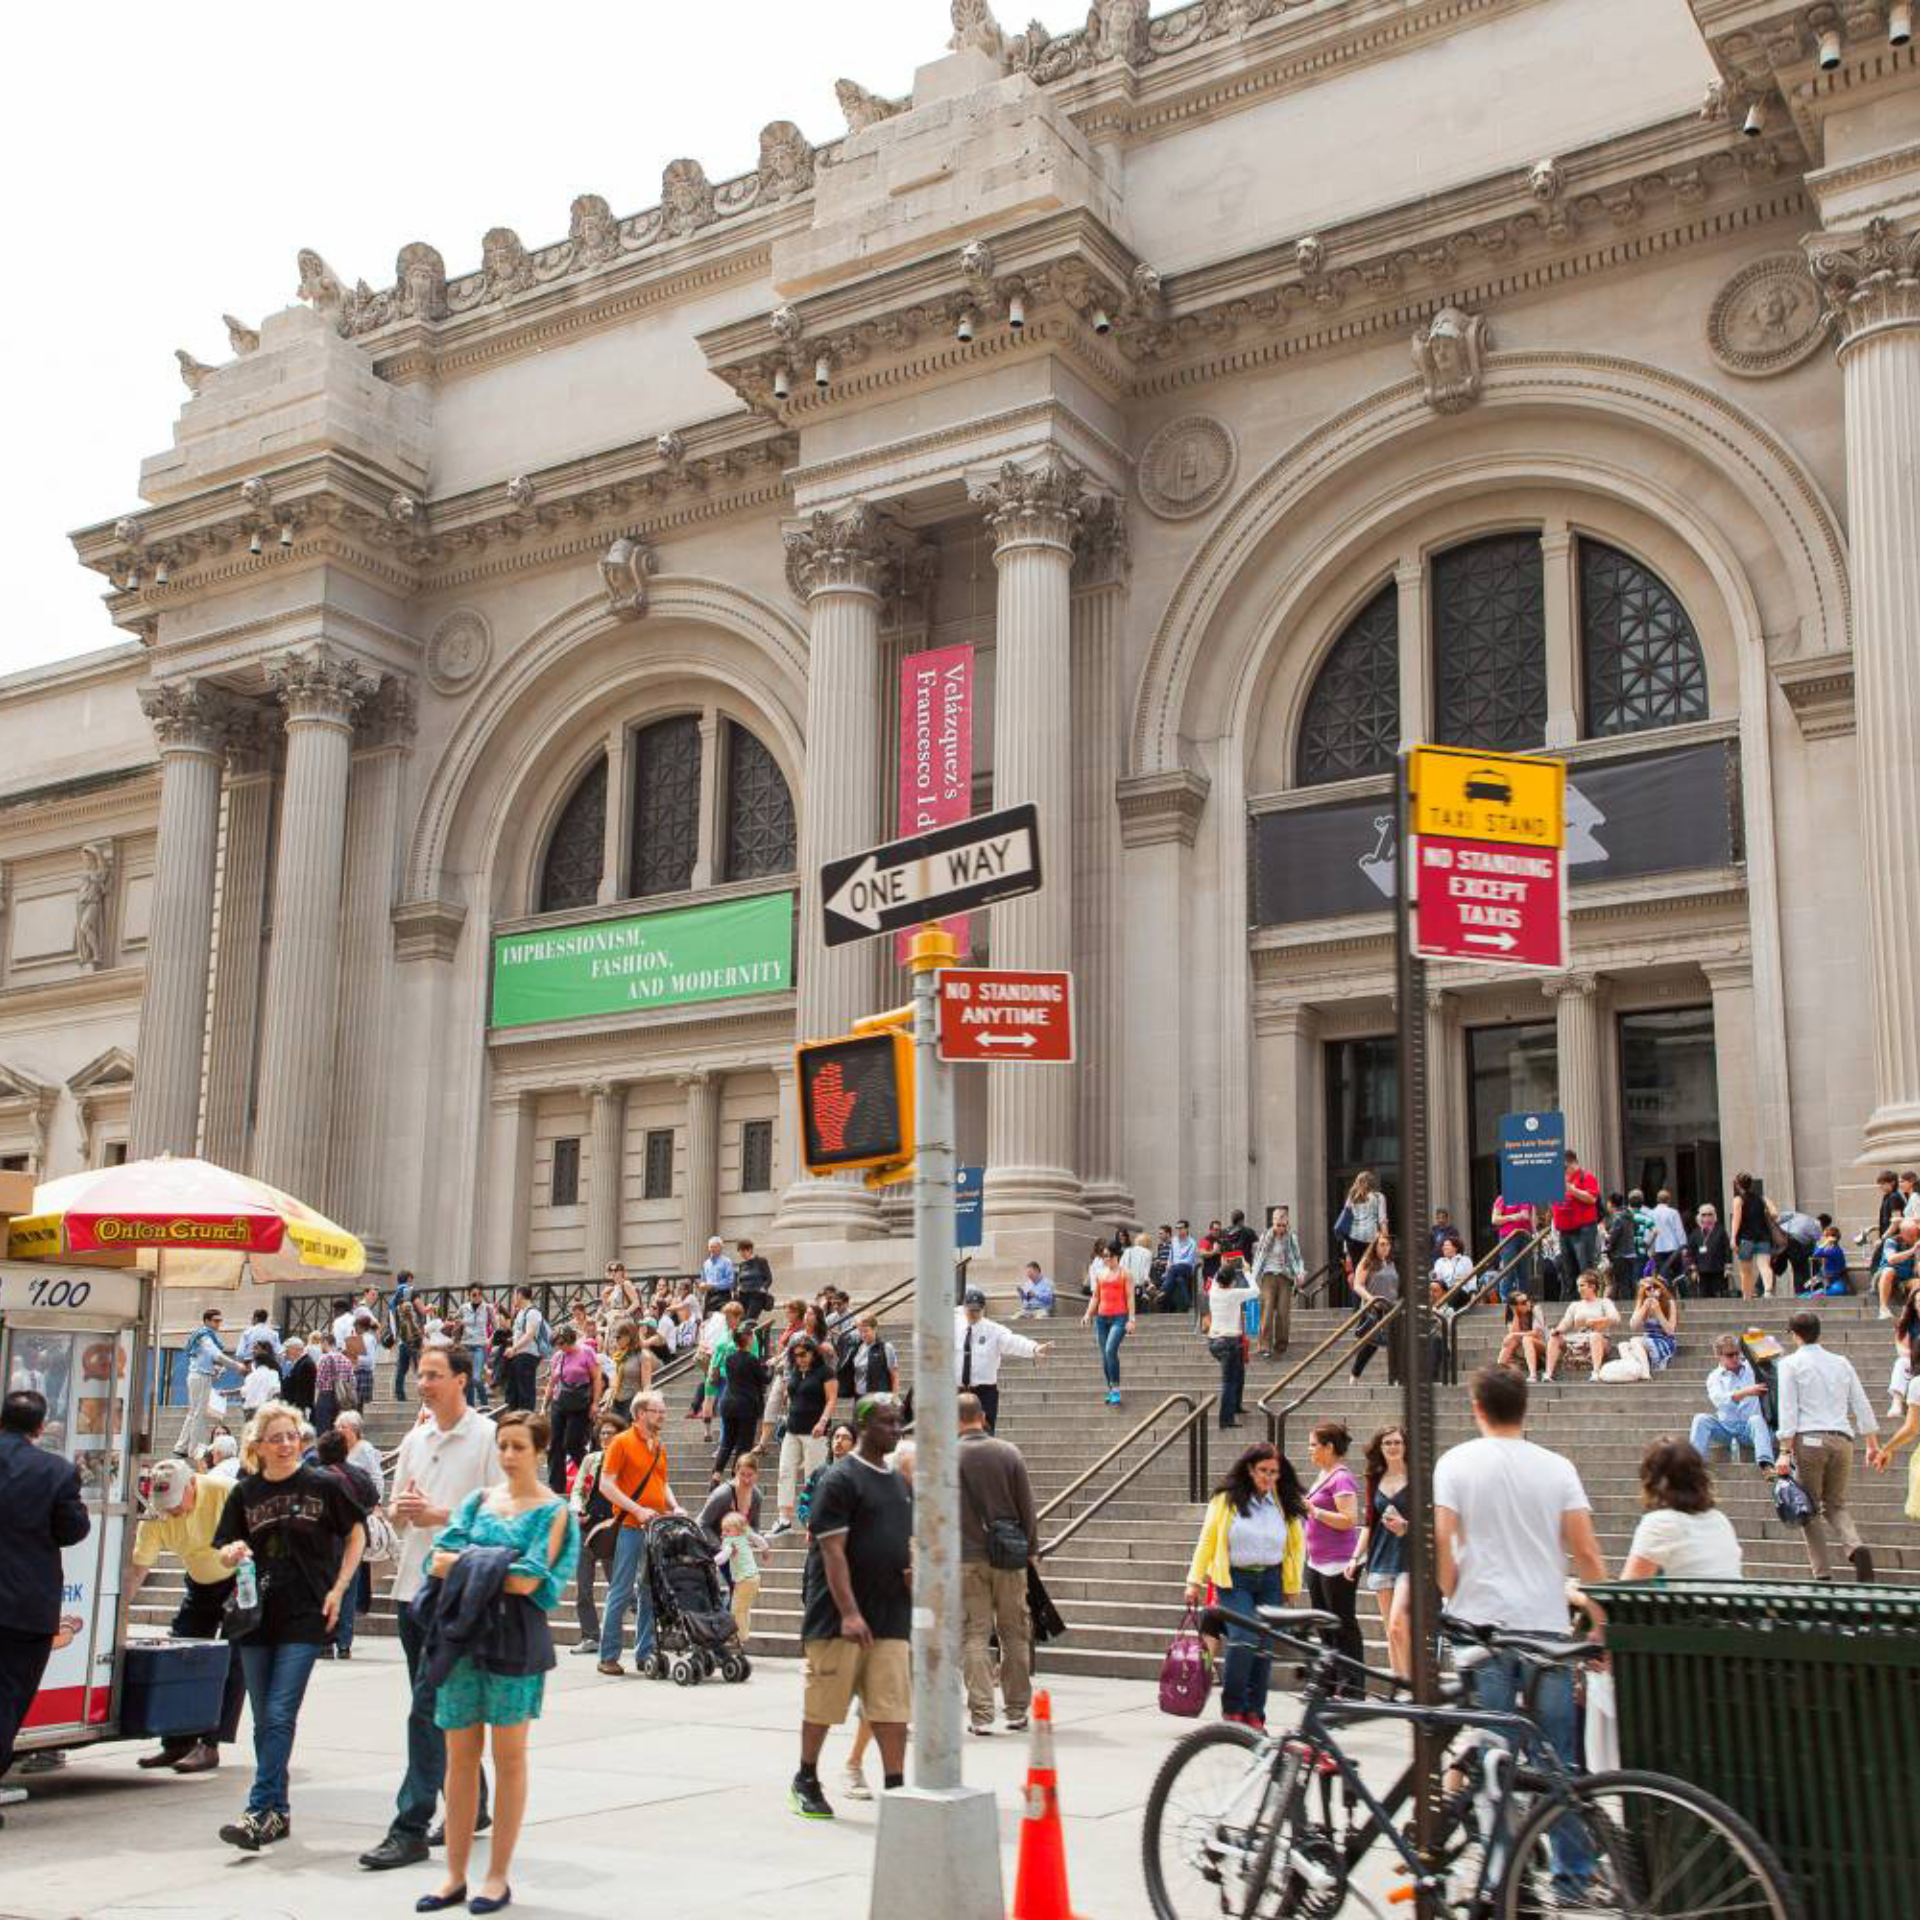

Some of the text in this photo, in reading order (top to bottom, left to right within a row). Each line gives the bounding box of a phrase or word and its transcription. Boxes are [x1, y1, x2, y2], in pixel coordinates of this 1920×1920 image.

[917, 669, 936, 788] Francesco
[938, 662, 965, 799] Velázquez's
[1430, 807, 1548, 838] TAXI STAND
[850, 839, 1011, 912] ONE WAY
[1423, 847, 1553, 879] NO STANDING
[1449, 876, 1529, 903] EXCEPT
[1457, 903, 1522, 929] TAXIS
[502, 927, 645, 966] IMPRESSIONISM,
[591, 950, 674, 979] FASHION,
[627, 960, 783, 1000] AND MODERNITY
[945, 982, 1063, 1001] NO STANDING
[961, 1007, 1051, 1026] ANYTIME
[97, 1217, 251, 1243] Onion Crunch
[29, 1277, 91, 1307] $1.00
